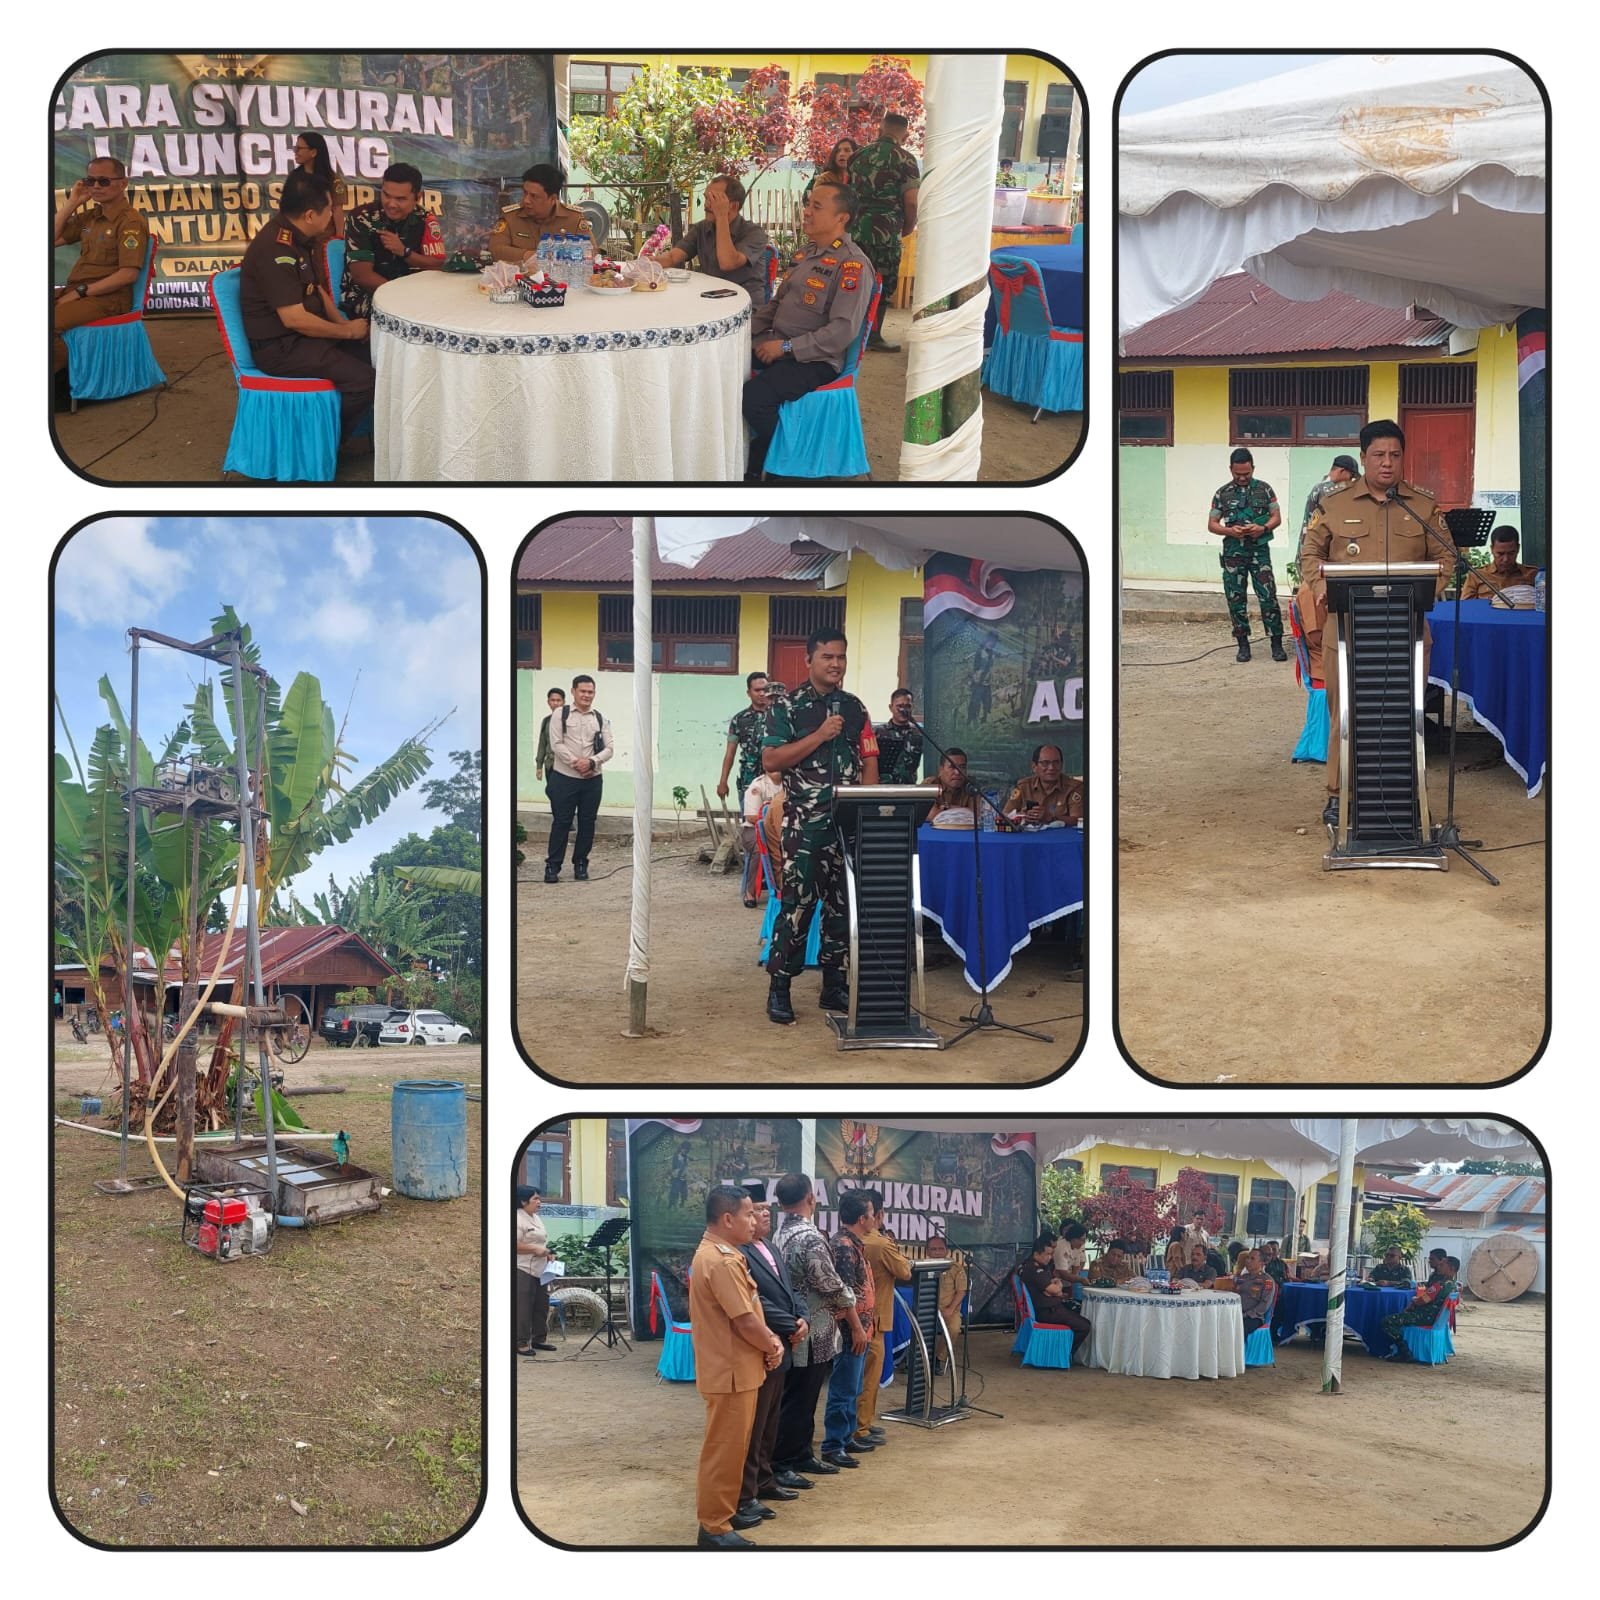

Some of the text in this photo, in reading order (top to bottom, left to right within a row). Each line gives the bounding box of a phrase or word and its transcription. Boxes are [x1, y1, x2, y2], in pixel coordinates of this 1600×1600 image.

[192, 83, 454, 137] SYUKURAN
[94, 132, 389, 178] AUNCHNG
[222, 182, 261, 210] 50
[174, 259, 234, 274] DALAM
[156, 281, 210, 295] DIWILAY
